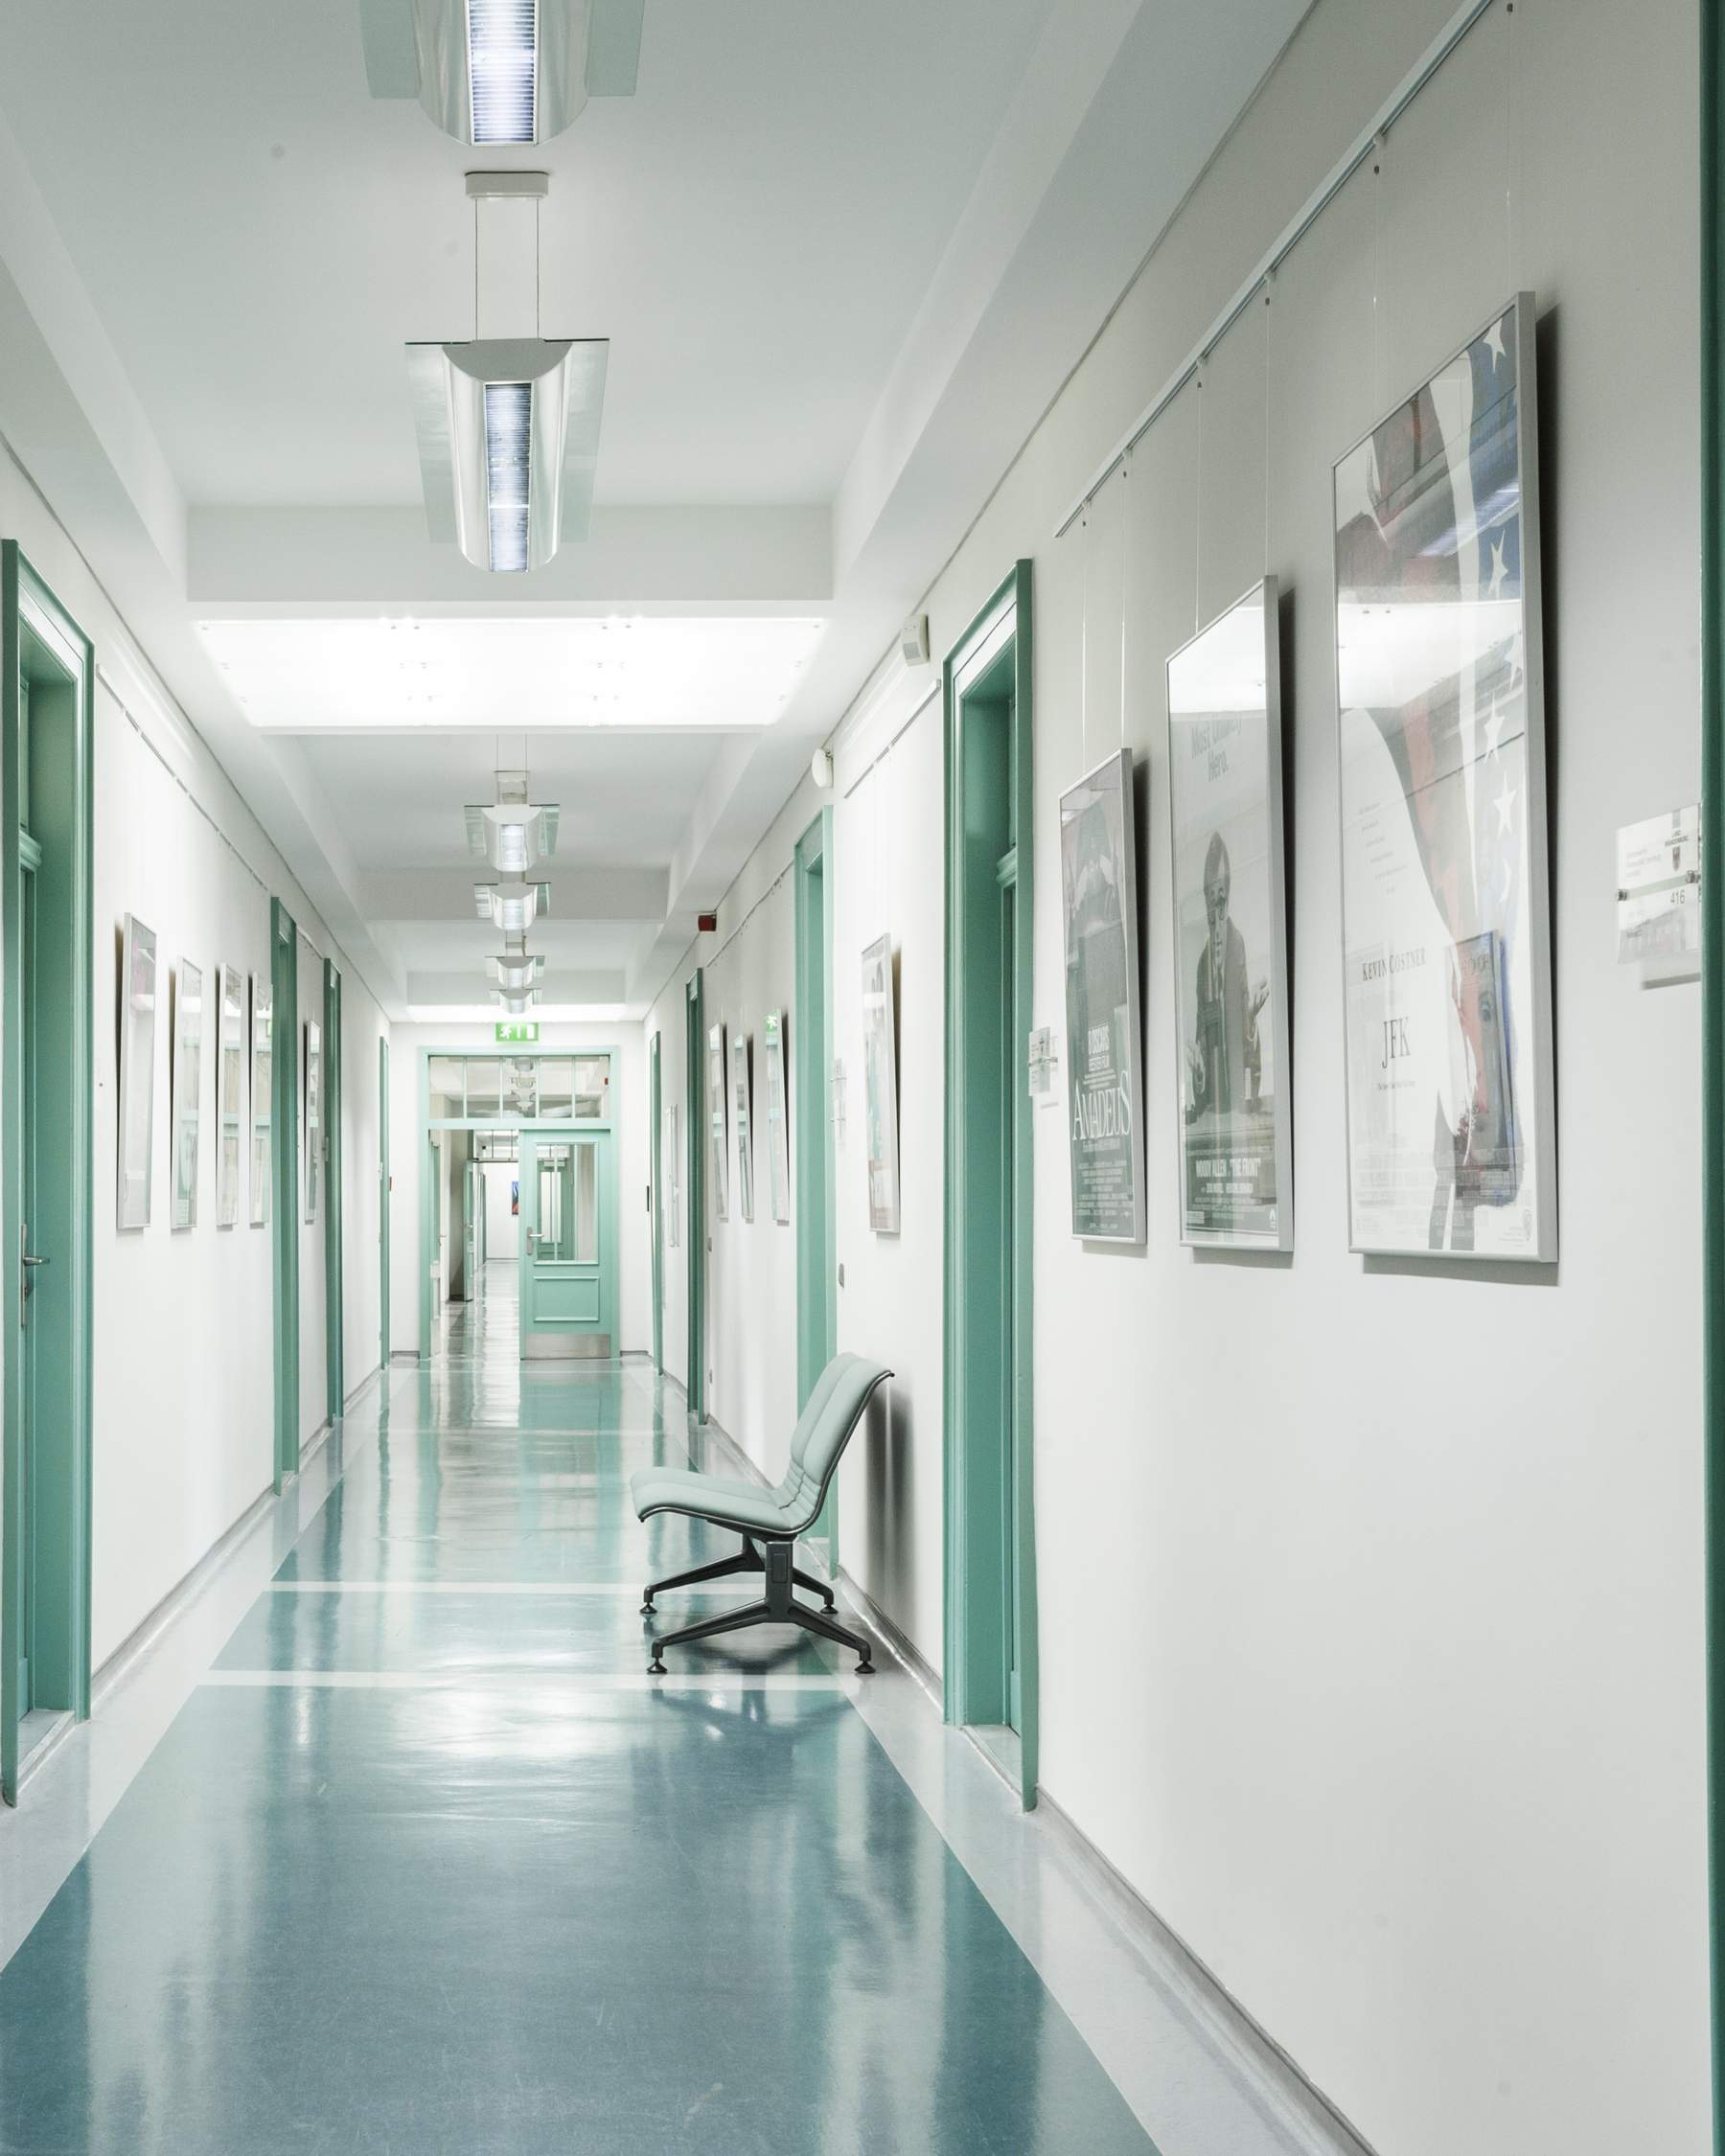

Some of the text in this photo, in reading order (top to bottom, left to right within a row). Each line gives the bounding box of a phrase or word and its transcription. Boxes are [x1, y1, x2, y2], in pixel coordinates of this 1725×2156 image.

[1669, 889, 1686, 906] 416
[1362, 948, 1427, 981] KEVIN COSTNER
[1381, 1016, 1412, 1069] JFK
[1072, 1069, 1131, 1140] AMADEUS
